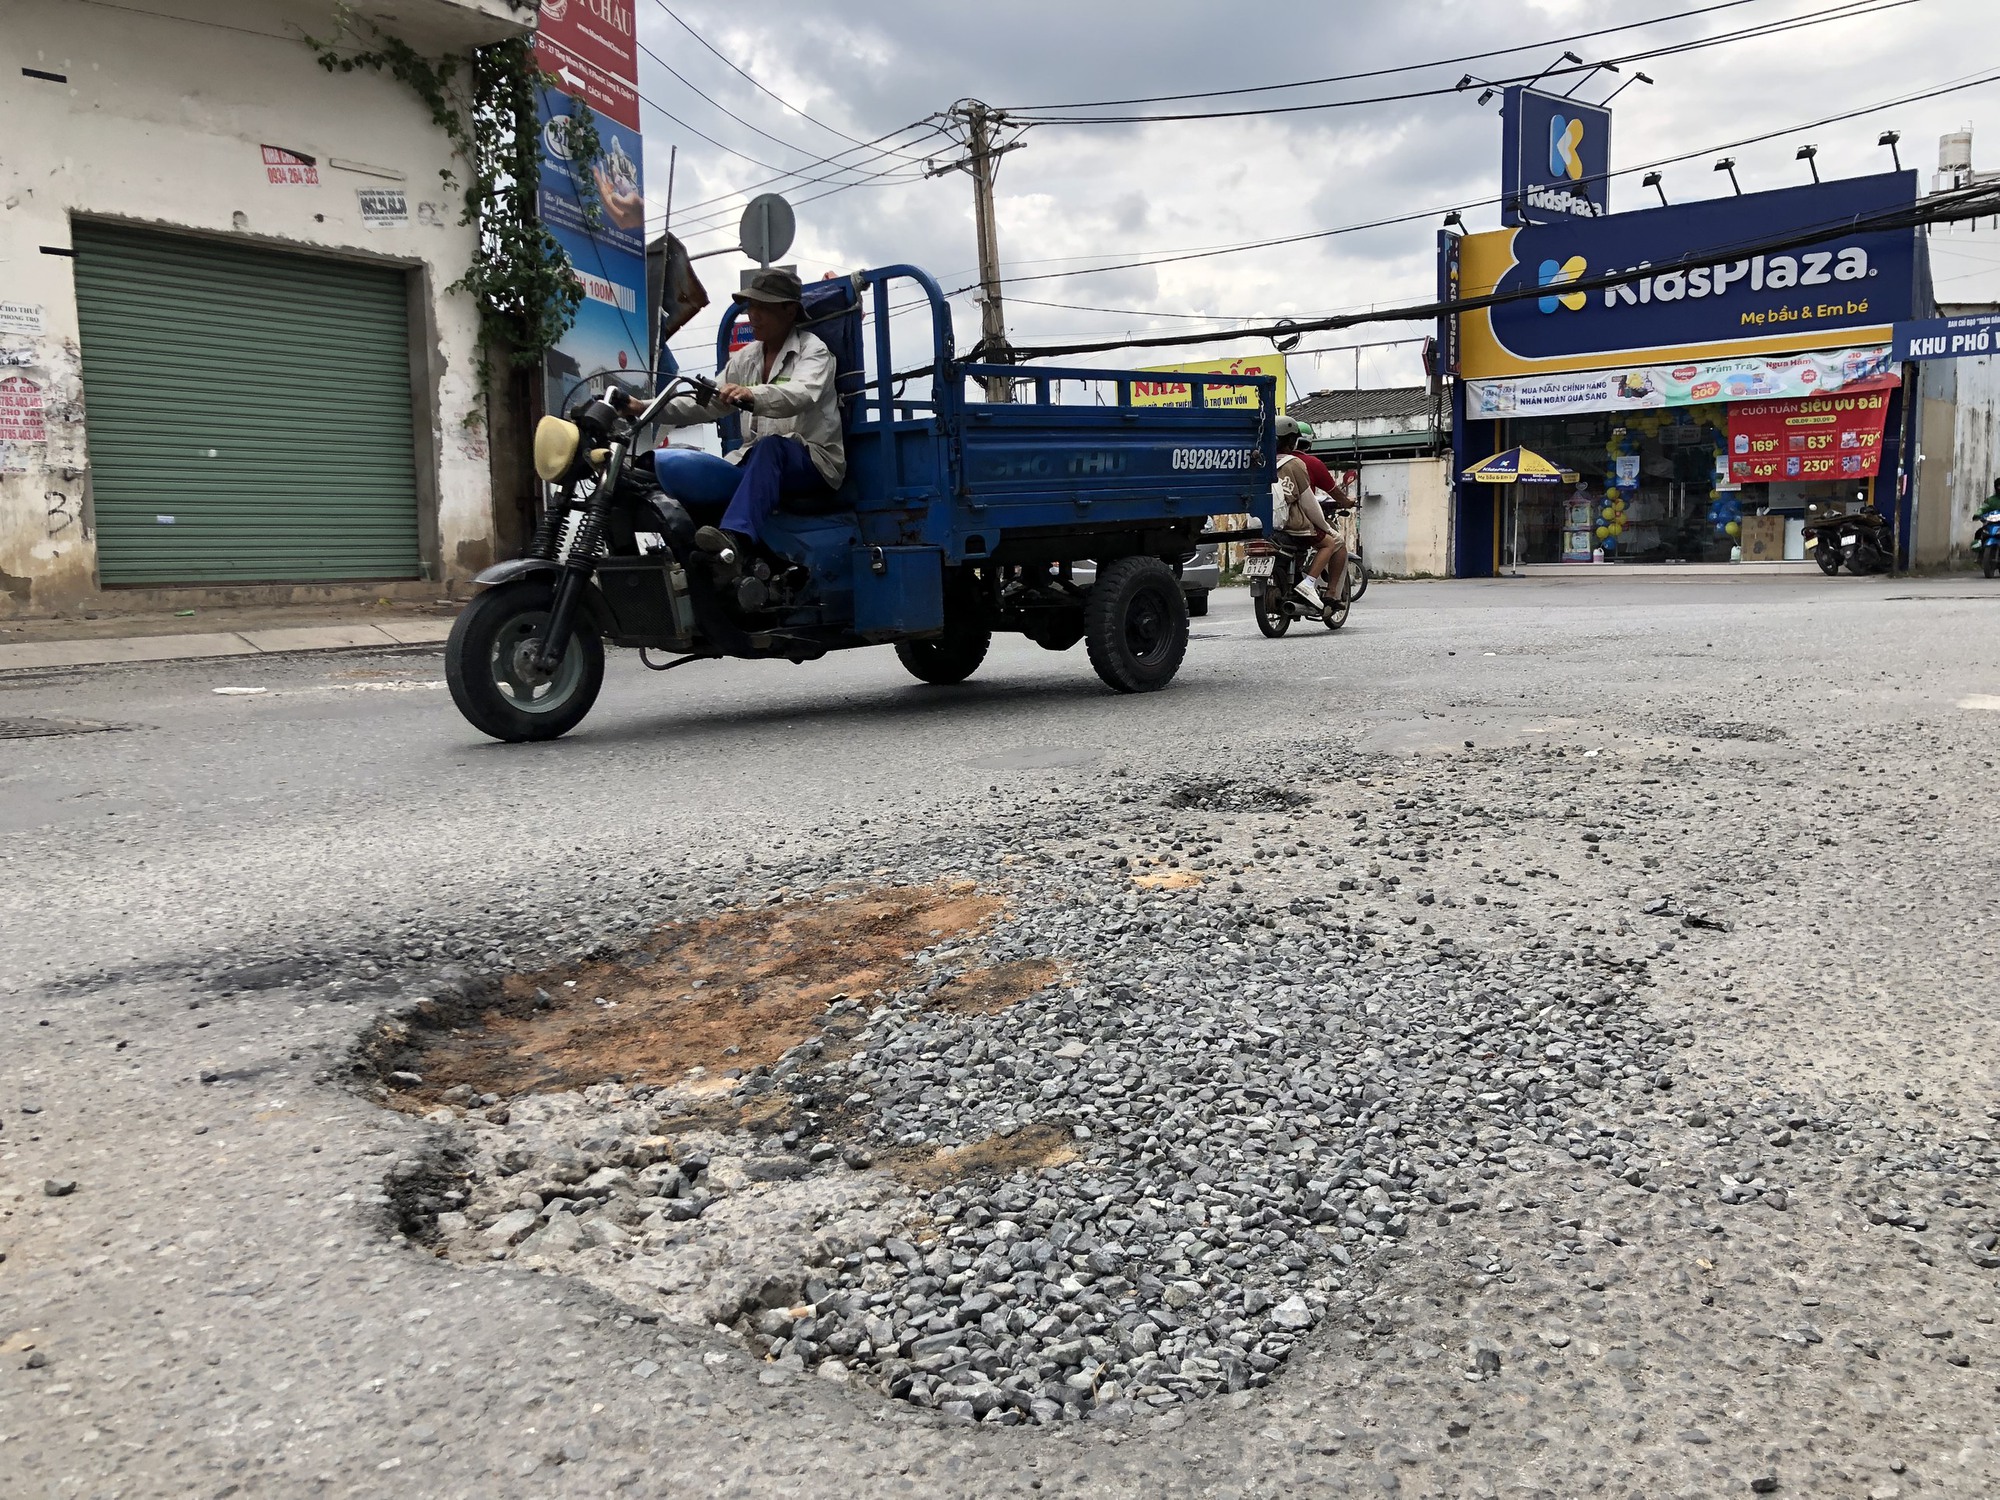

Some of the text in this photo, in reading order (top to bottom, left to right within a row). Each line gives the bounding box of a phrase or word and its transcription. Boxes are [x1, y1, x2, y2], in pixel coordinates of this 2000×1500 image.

[304, 168, 319, 185] 323
[1527, 184, 1603, 218] KidsPlaza
[1604, 247, 1868, 307] KidsPlaza
[590, 280, 613, 302] 100M
[1740, 298, 1869, 326] Mẹ bầu & Em bé
[1910, 336, 1947, 356] KHU
[1951, 326, 1990, 353] PHỐ
[1562, 382, 1585, 392] CHÍNH
[1585, 392, 1607, 400] SANG
[1223, 397, 1233, 406] VAY
[1235, 394, 1248, 405] VỐN
[1741, 404, 1767, 416] CUỐI
[1770, 402, 1798, 414] TUẦN
[1, 408, 20, 416] CHO
[1751, 439, 1779, 452] 169K
[1807, 434, 1833, 449] 63K
[1172, 449, 1250, 470] 0392842315
[1754, 464, 1777, 476] 49K
[1803, 458, 1834, 473] 230K
